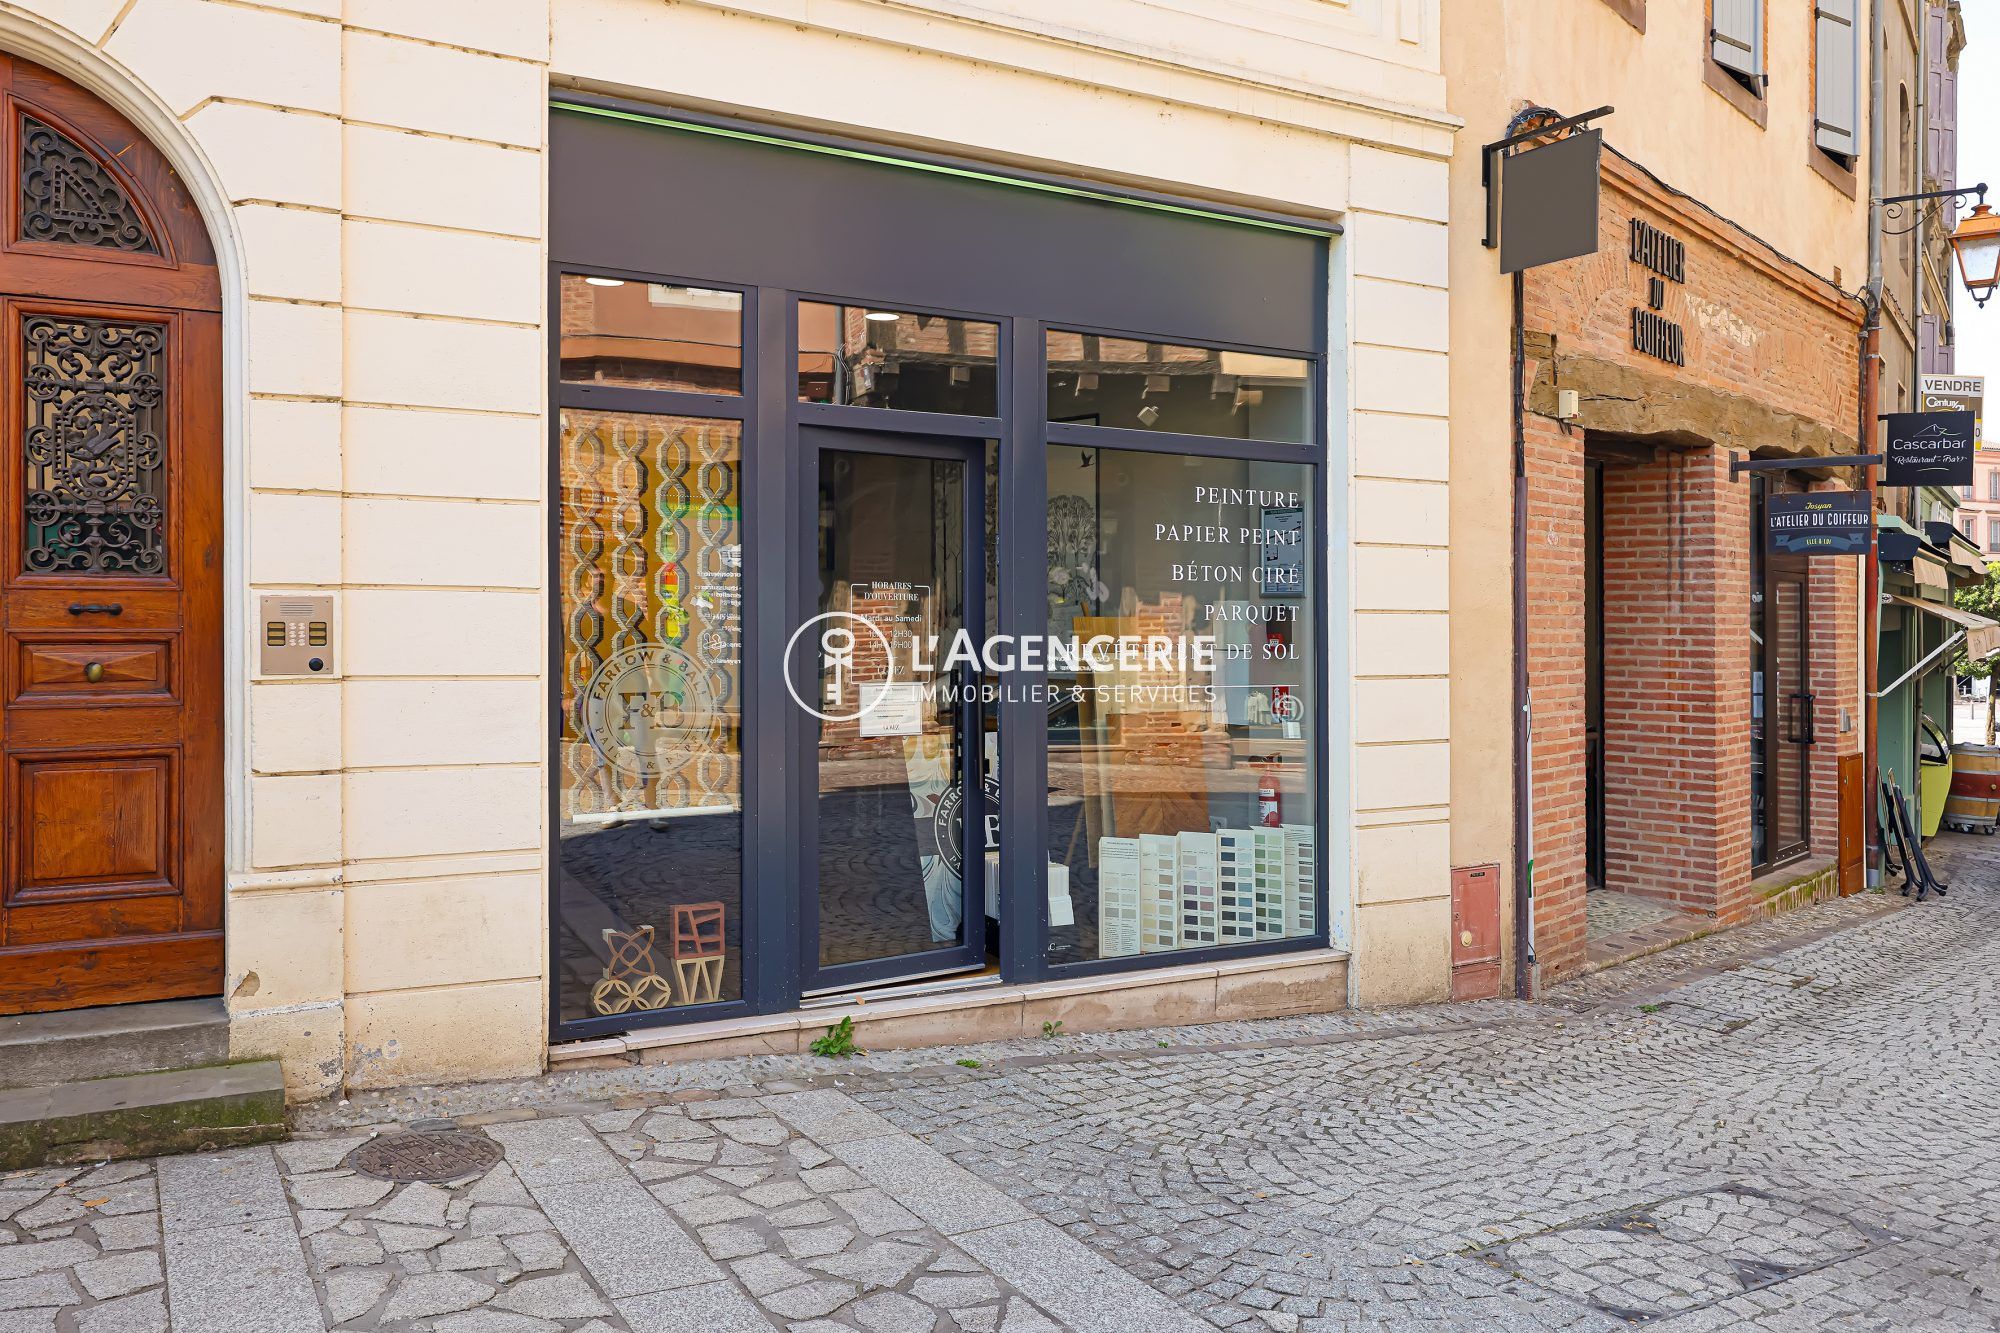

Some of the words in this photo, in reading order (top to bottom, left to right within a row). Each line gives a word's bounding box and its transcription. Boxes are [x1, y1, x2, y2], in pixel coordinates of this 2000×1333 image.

[1630, 218, 1685, 284] L'ATELIER
[1632, 307, 1685, 367] COIFFEUR
[1924, 379, 1981, 392] VENDRE
[1926, 396, 1959, 409] Century
[1893, 438, 1967, 450] Cascarbar
[1894, 455, 1936, 465] Restaurant
[1195, 486, 1299, 508] PEINTURE
[1770, 513, 1809, 528] L'ATELIER
[1812, 513, 1824, 526] DU
[1827, 512, 1869, 526] COIFFEUR
[1154, 523, 1231, 544] PAPIER
[1240, 527, 1299, 546] PEINT
[1172, 560, 1242, 583] BÉTON
[1252, 564, 1299, 584] CIRÉ
[871, 581, 912, 590] HORAIRES
[864, 592, 920, 601] D'OUVERTURE
[895, 614, 922, 622] Samedi
[1204, 604, 1300, 625] PARQUET
[889, 630, 912, 638] 12H30
[1227, 643, 1253, 660] DE
[1262, 643, 1300, 660] SOL
